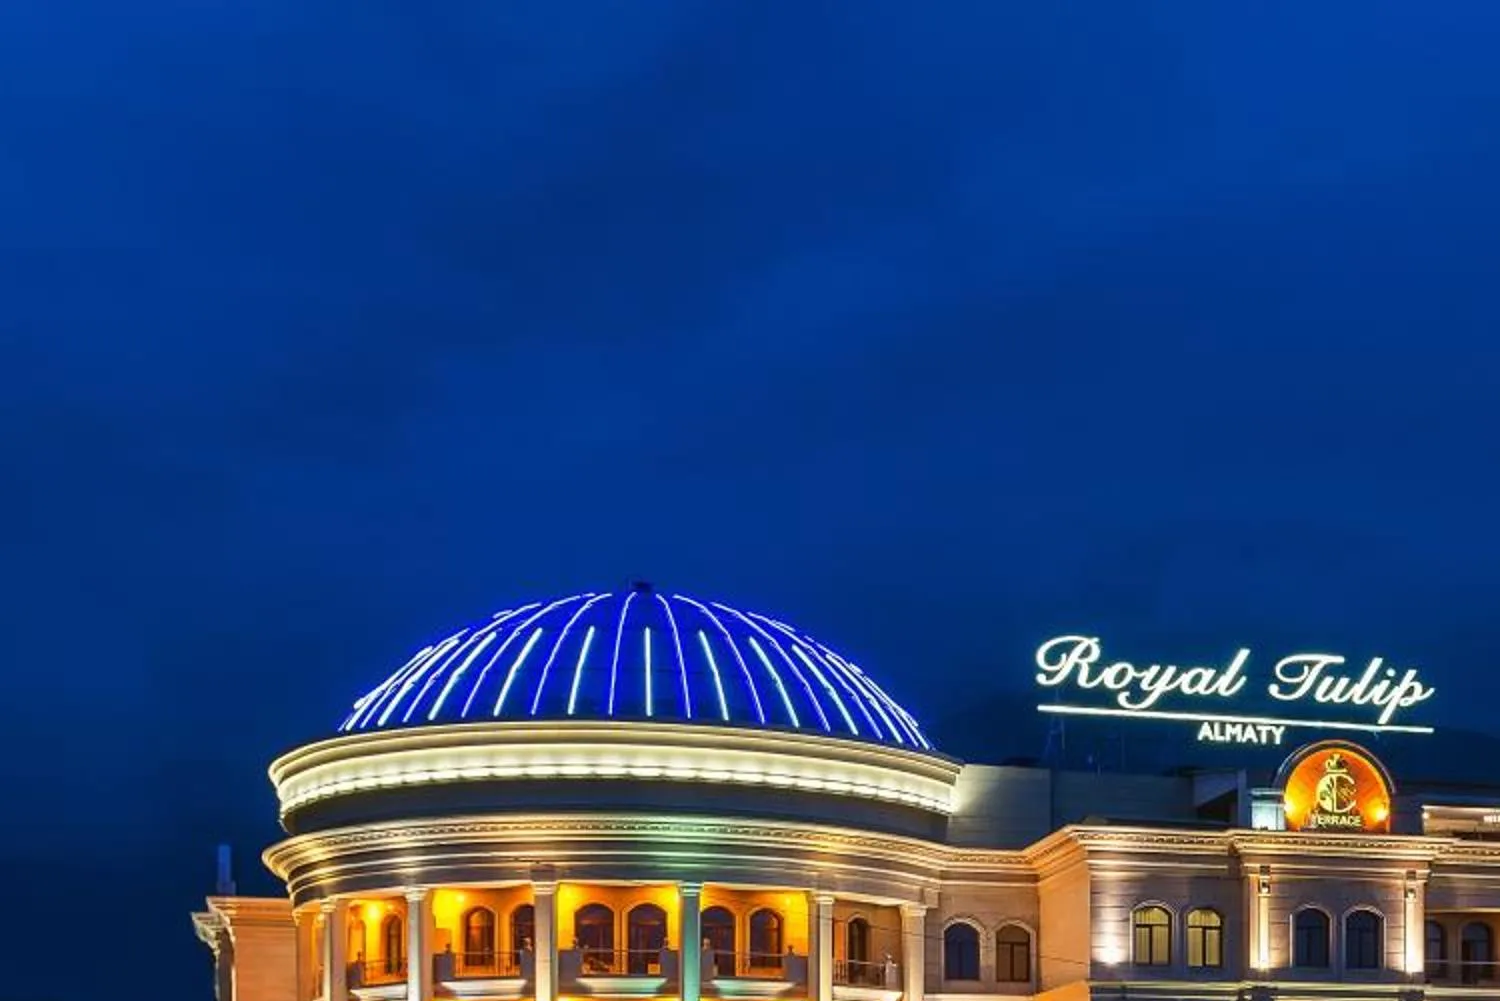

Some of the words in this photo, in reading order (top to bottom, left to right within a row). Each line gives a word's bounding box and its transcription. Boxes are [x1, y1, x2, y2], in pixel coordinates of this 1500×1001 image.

[1035, 634, 1251, 711] Royal
[1268, 653, 1435, 725] Tulip
[1197, 721, 1285, 745] ALMATY
[1311, 813, 1362, 828] TERRACE
